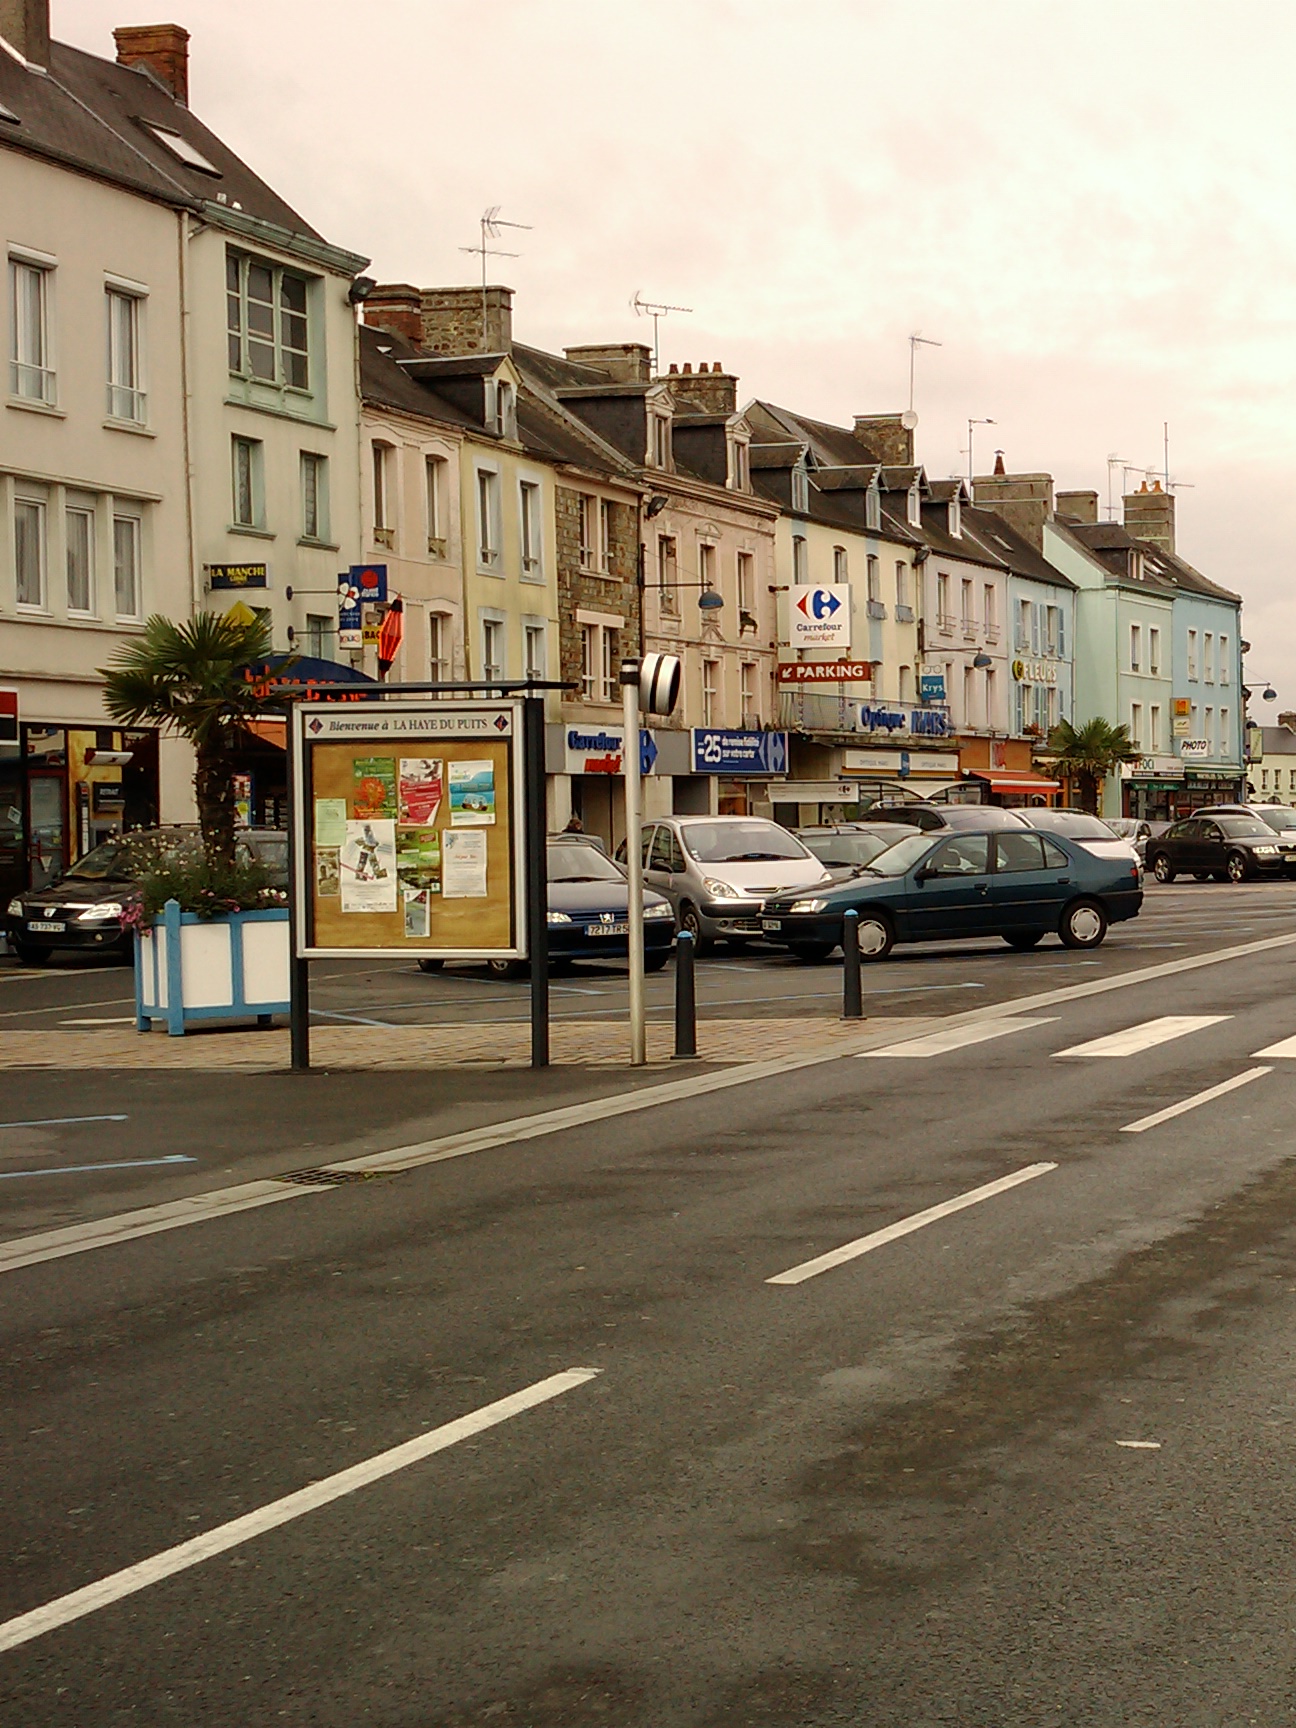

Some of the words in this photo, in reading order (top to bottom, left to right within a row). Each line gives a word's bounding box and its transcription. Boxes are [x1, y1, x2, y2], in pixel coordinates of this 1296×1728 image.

[211, 568, 223, 577] LA
[227, 566, 264, 576] MANCHE
[797, 623, 842, 632] Carrefour
[804, 633, 835, 641] market
[797, 665, 863, 678] PARKING
[1024, 661, 1057, 681] FLEURS
[922, 683, 943, 694] Krys
[382, 722, 389, 731] à
[394, 720, 407, 730] LA
[409, 720, 438, 730] HAYE
[440, 719, 455, 729] DU
[458, 718, 488, 729] PUITS
[568, 731, 622, 751] Carrefour
[1181, 741, 1206, 750] PHOTO
